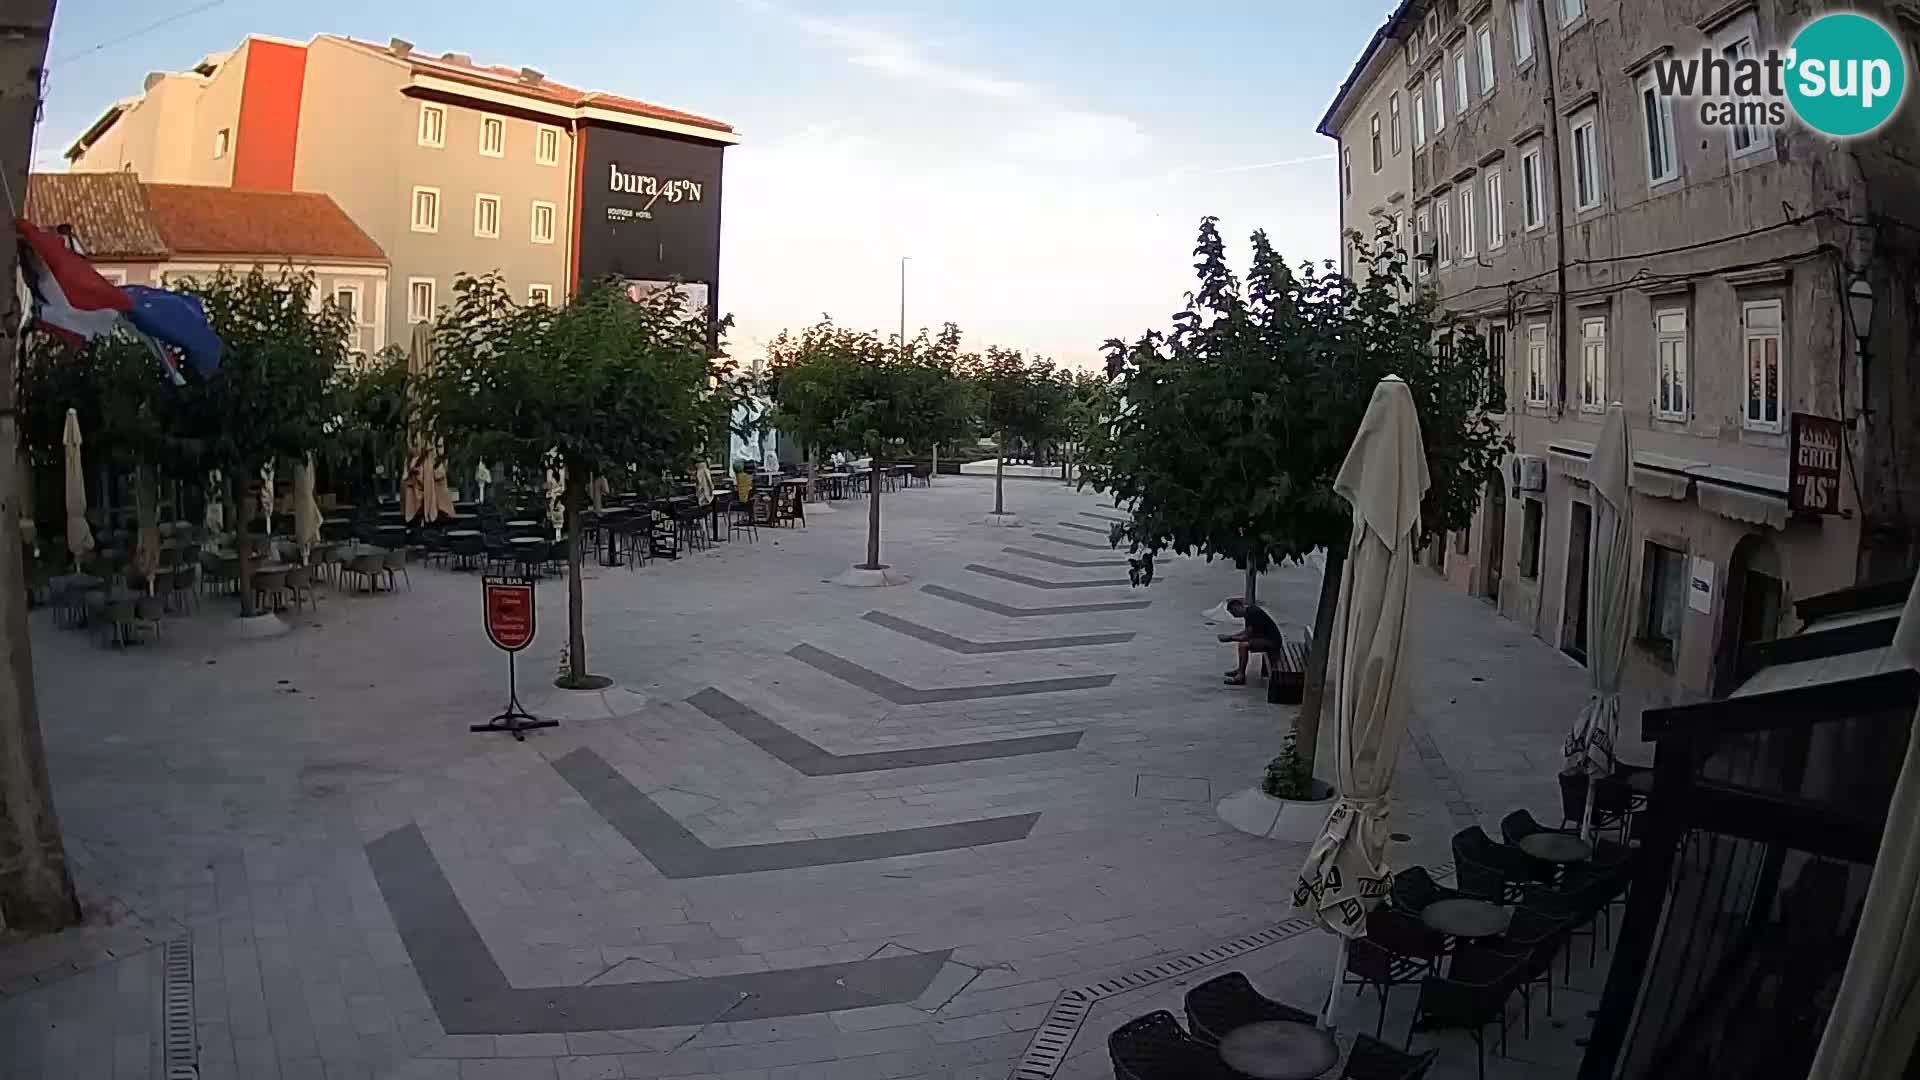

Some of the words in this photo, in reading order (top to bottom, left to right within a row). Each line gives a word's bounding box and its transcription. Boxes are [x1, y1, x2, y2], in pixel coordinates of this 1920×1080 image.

[610, 164, 657, 195] bura
[636, 211, 652, 219] HOTEL
[1798, 446, 1838, 471] GRILL
